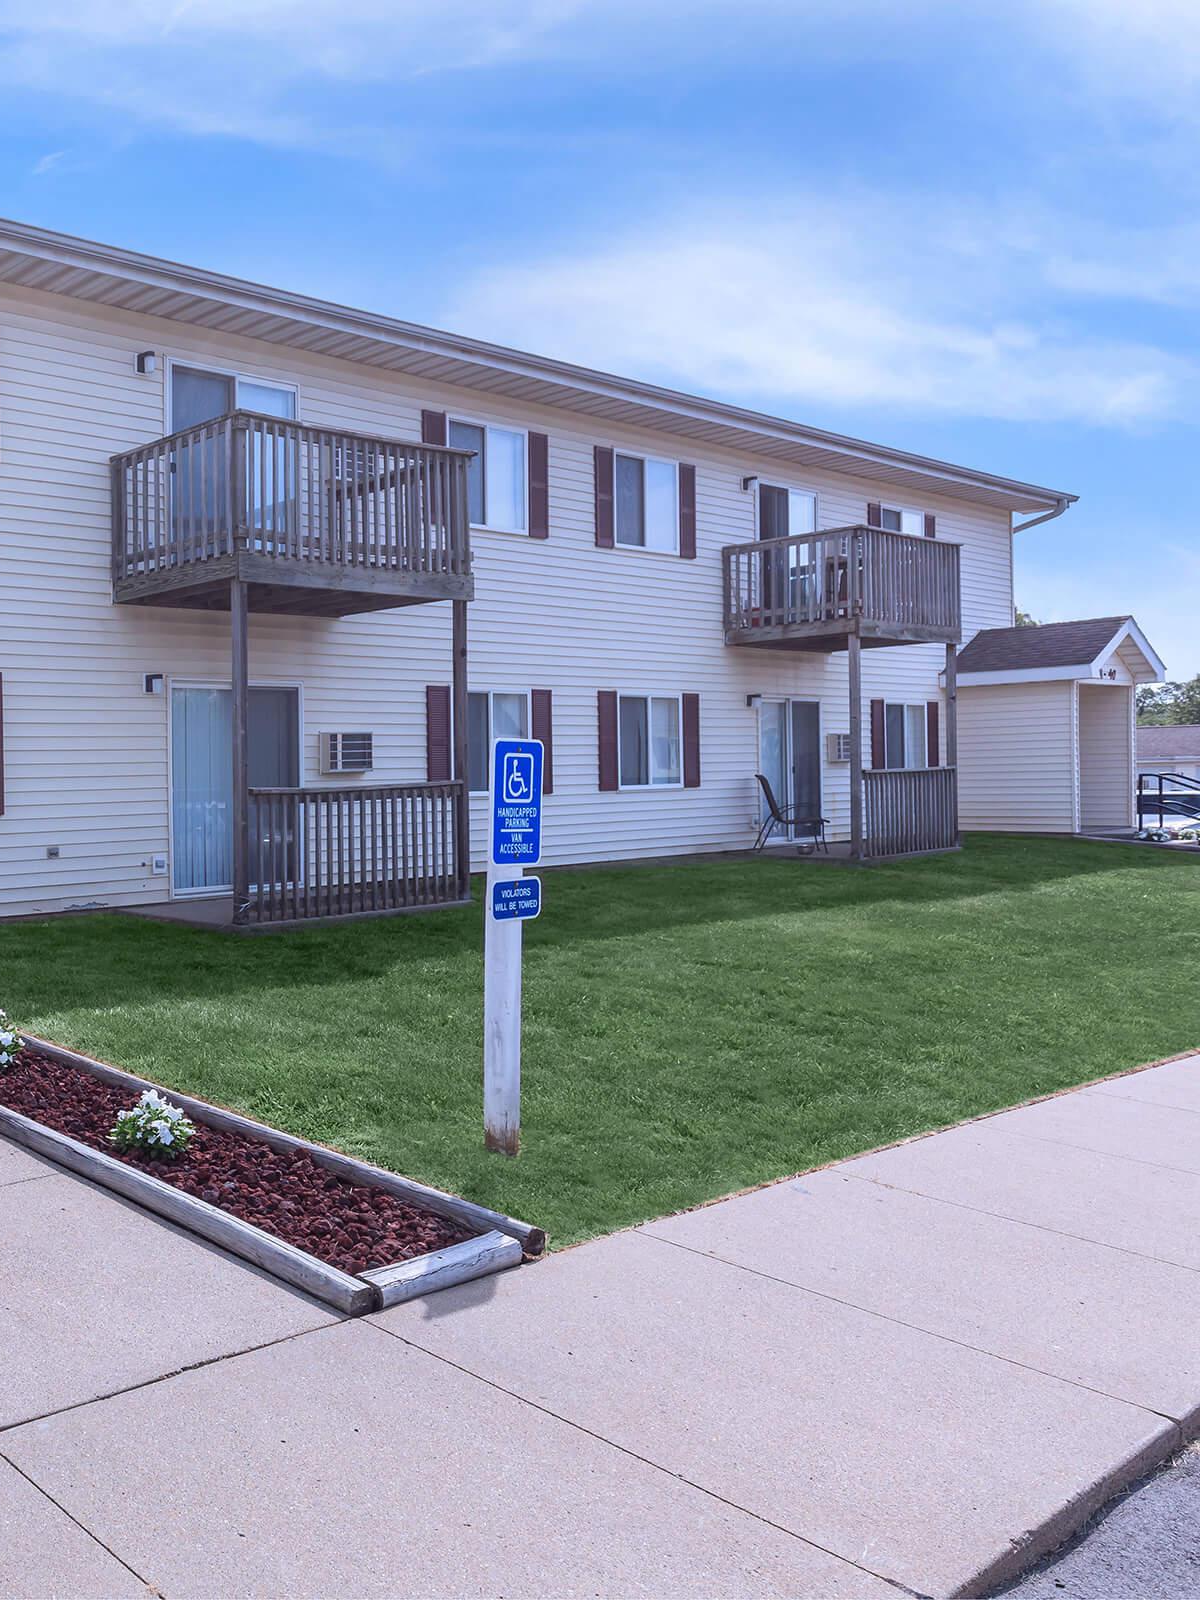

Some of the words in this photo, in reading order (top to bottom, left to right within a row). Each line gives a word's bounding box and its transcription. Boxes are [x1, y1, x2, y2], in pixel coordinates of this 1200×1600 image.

[497, 807, 537, 818] HANDICAPPED
[505, 817, 529, 828] PARKING
[511, 832, 522, 843] VAN
[500, 843, 533, 853] ACCESSIBLE
[501, 888, 531, 898] VIOLATORS
[494, 902, 508, 912] WILL
[509, 901, 517, 911] BE
[518, 899, 538, 909] TOWED
